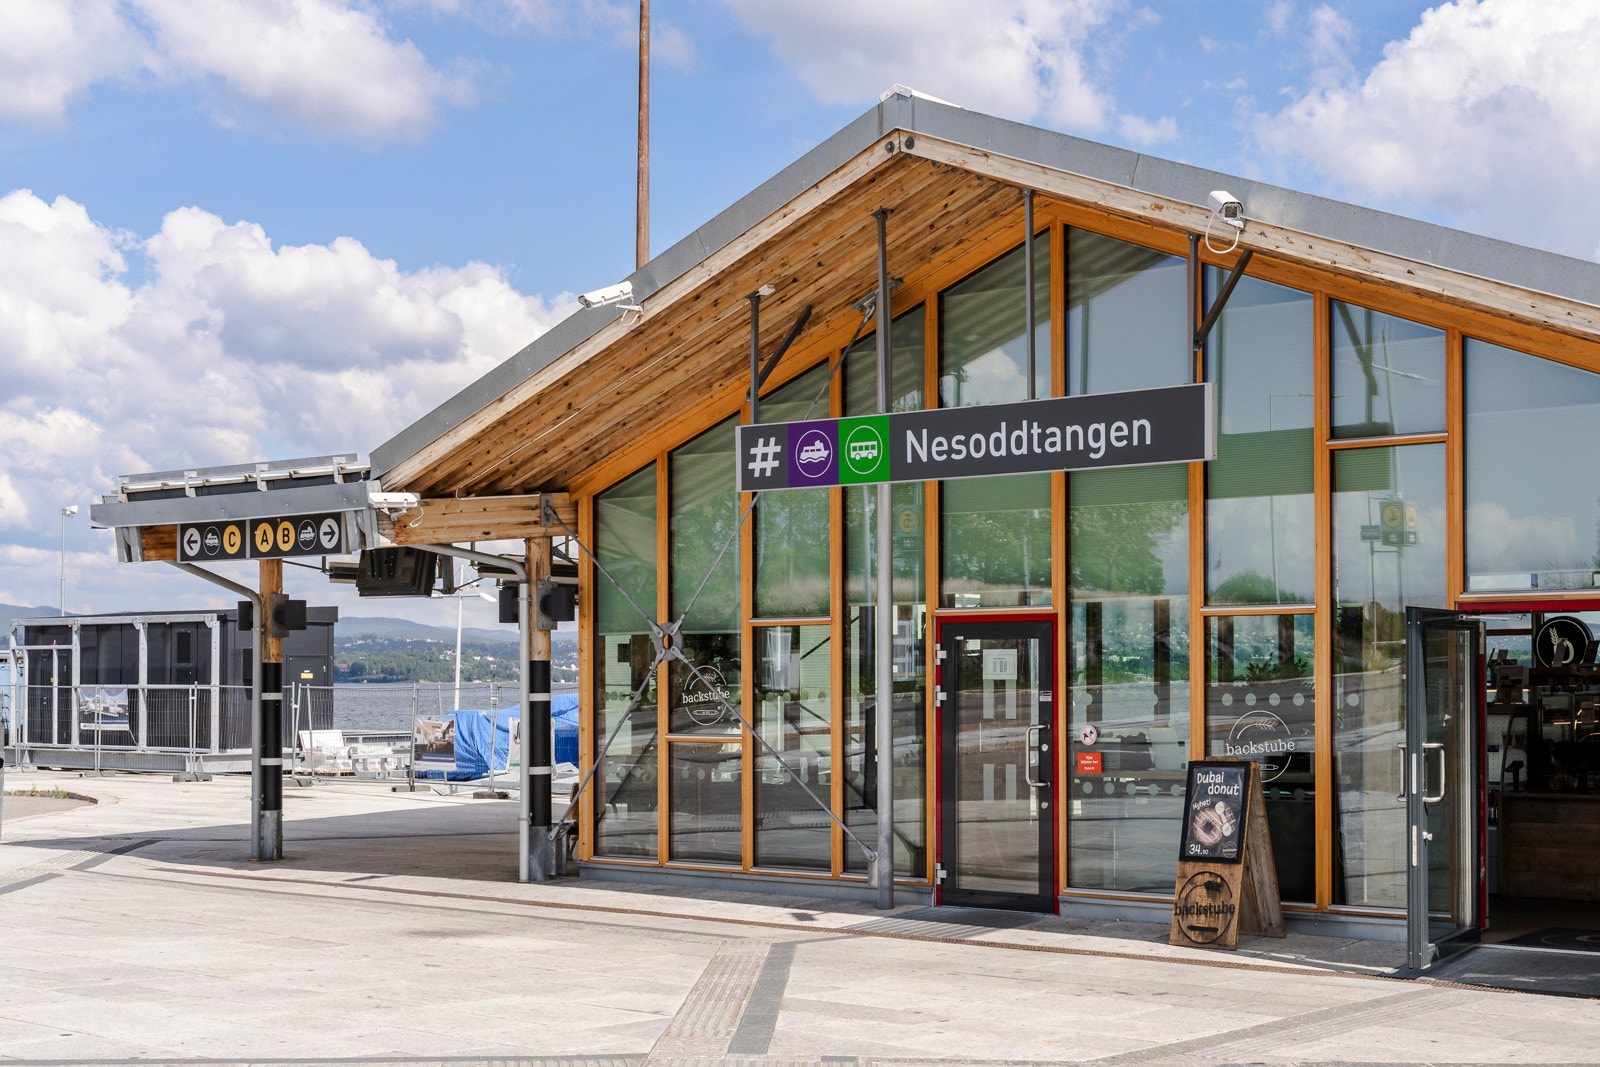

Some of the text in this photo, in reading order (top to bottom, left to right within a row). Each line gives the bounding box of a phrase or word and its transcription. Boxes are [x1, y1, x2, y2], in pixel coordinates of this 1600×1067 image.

[748, 418, 1152, 478] # Nesoddtangen
[228, 531, 236, 548] C
[260, 527, 290, 546] A B
[1226, 738, 1295, 756] backstube
[1196, 770, 1225, 784] Dubai
[1207, 783, 1240, 796] donut
[1174, 900, 1236, 917] backstube
